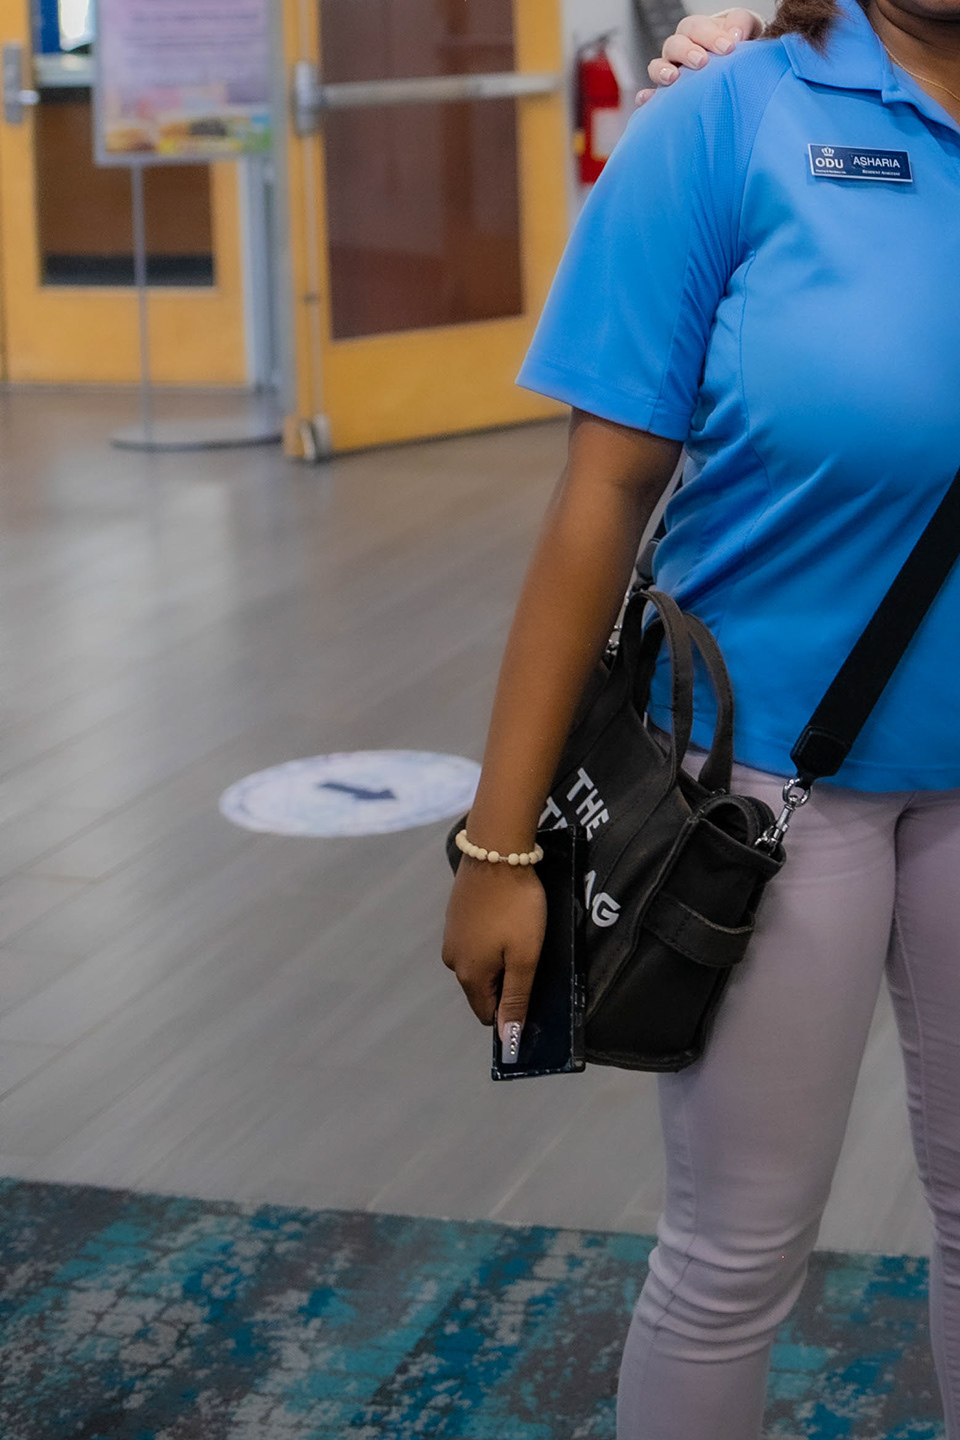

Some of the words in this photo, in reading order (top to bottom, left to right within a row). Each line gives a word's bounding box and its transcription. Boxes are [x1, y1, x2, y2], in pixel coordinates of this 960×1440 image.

[815, 157, 844, 169] ODU
[853, 156, 901, 169] ASHARIA
[566, 767, 610, 842] THE
